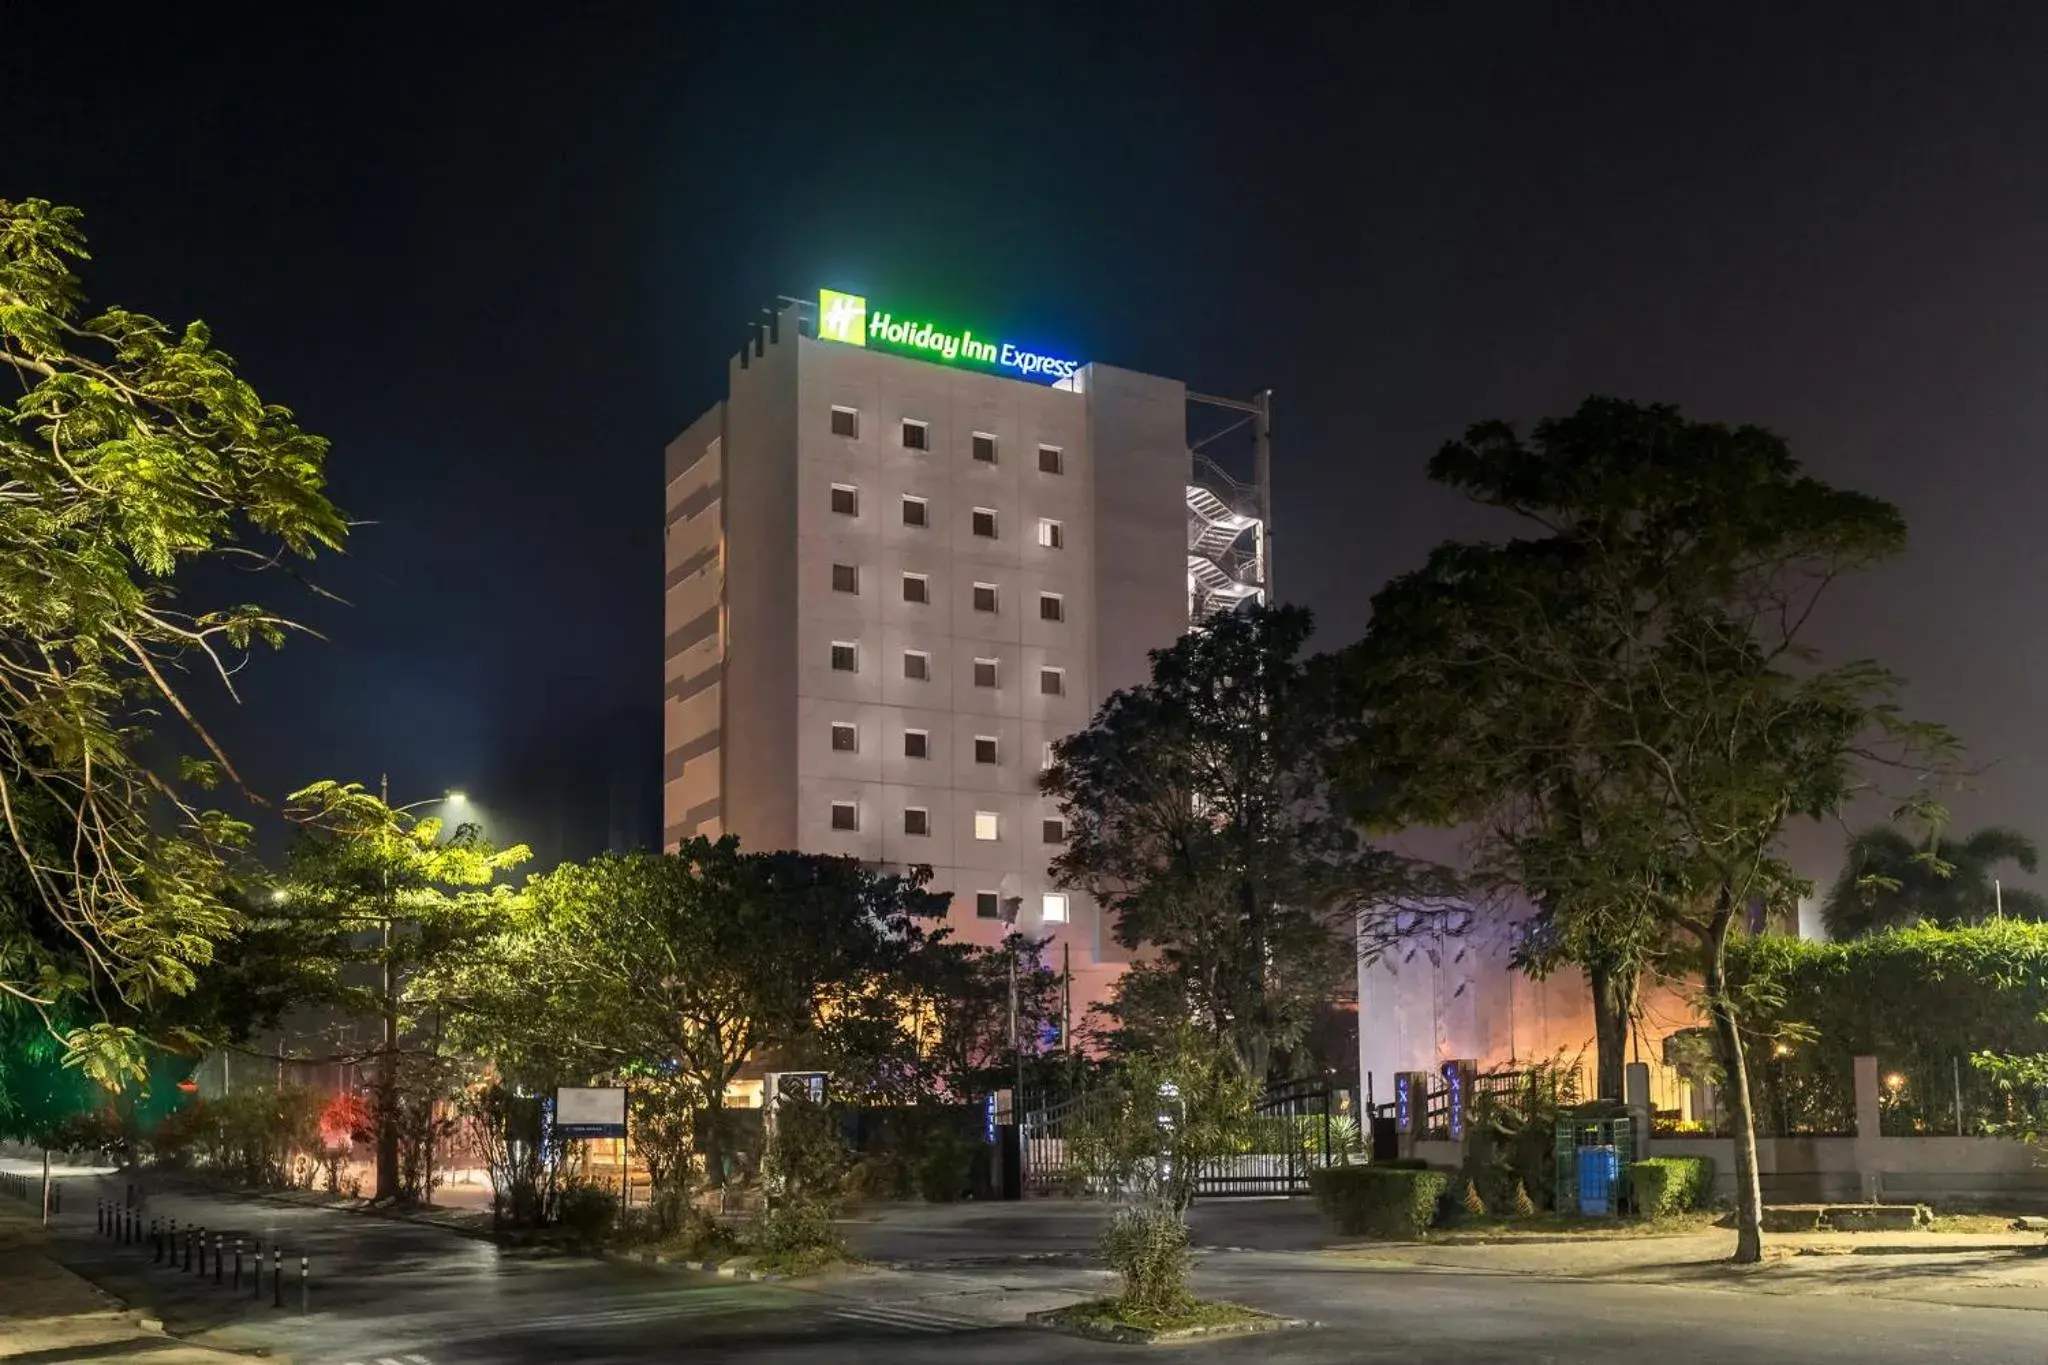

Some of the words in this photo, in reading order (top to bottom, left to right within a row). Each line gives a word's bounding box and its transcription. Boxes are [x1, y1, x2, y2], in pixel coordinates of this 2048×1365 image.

[868, 310, 960, 359] Holiday
[961, 330, 998, 363] Inn
[1000, 343, 1078, 377] Express
